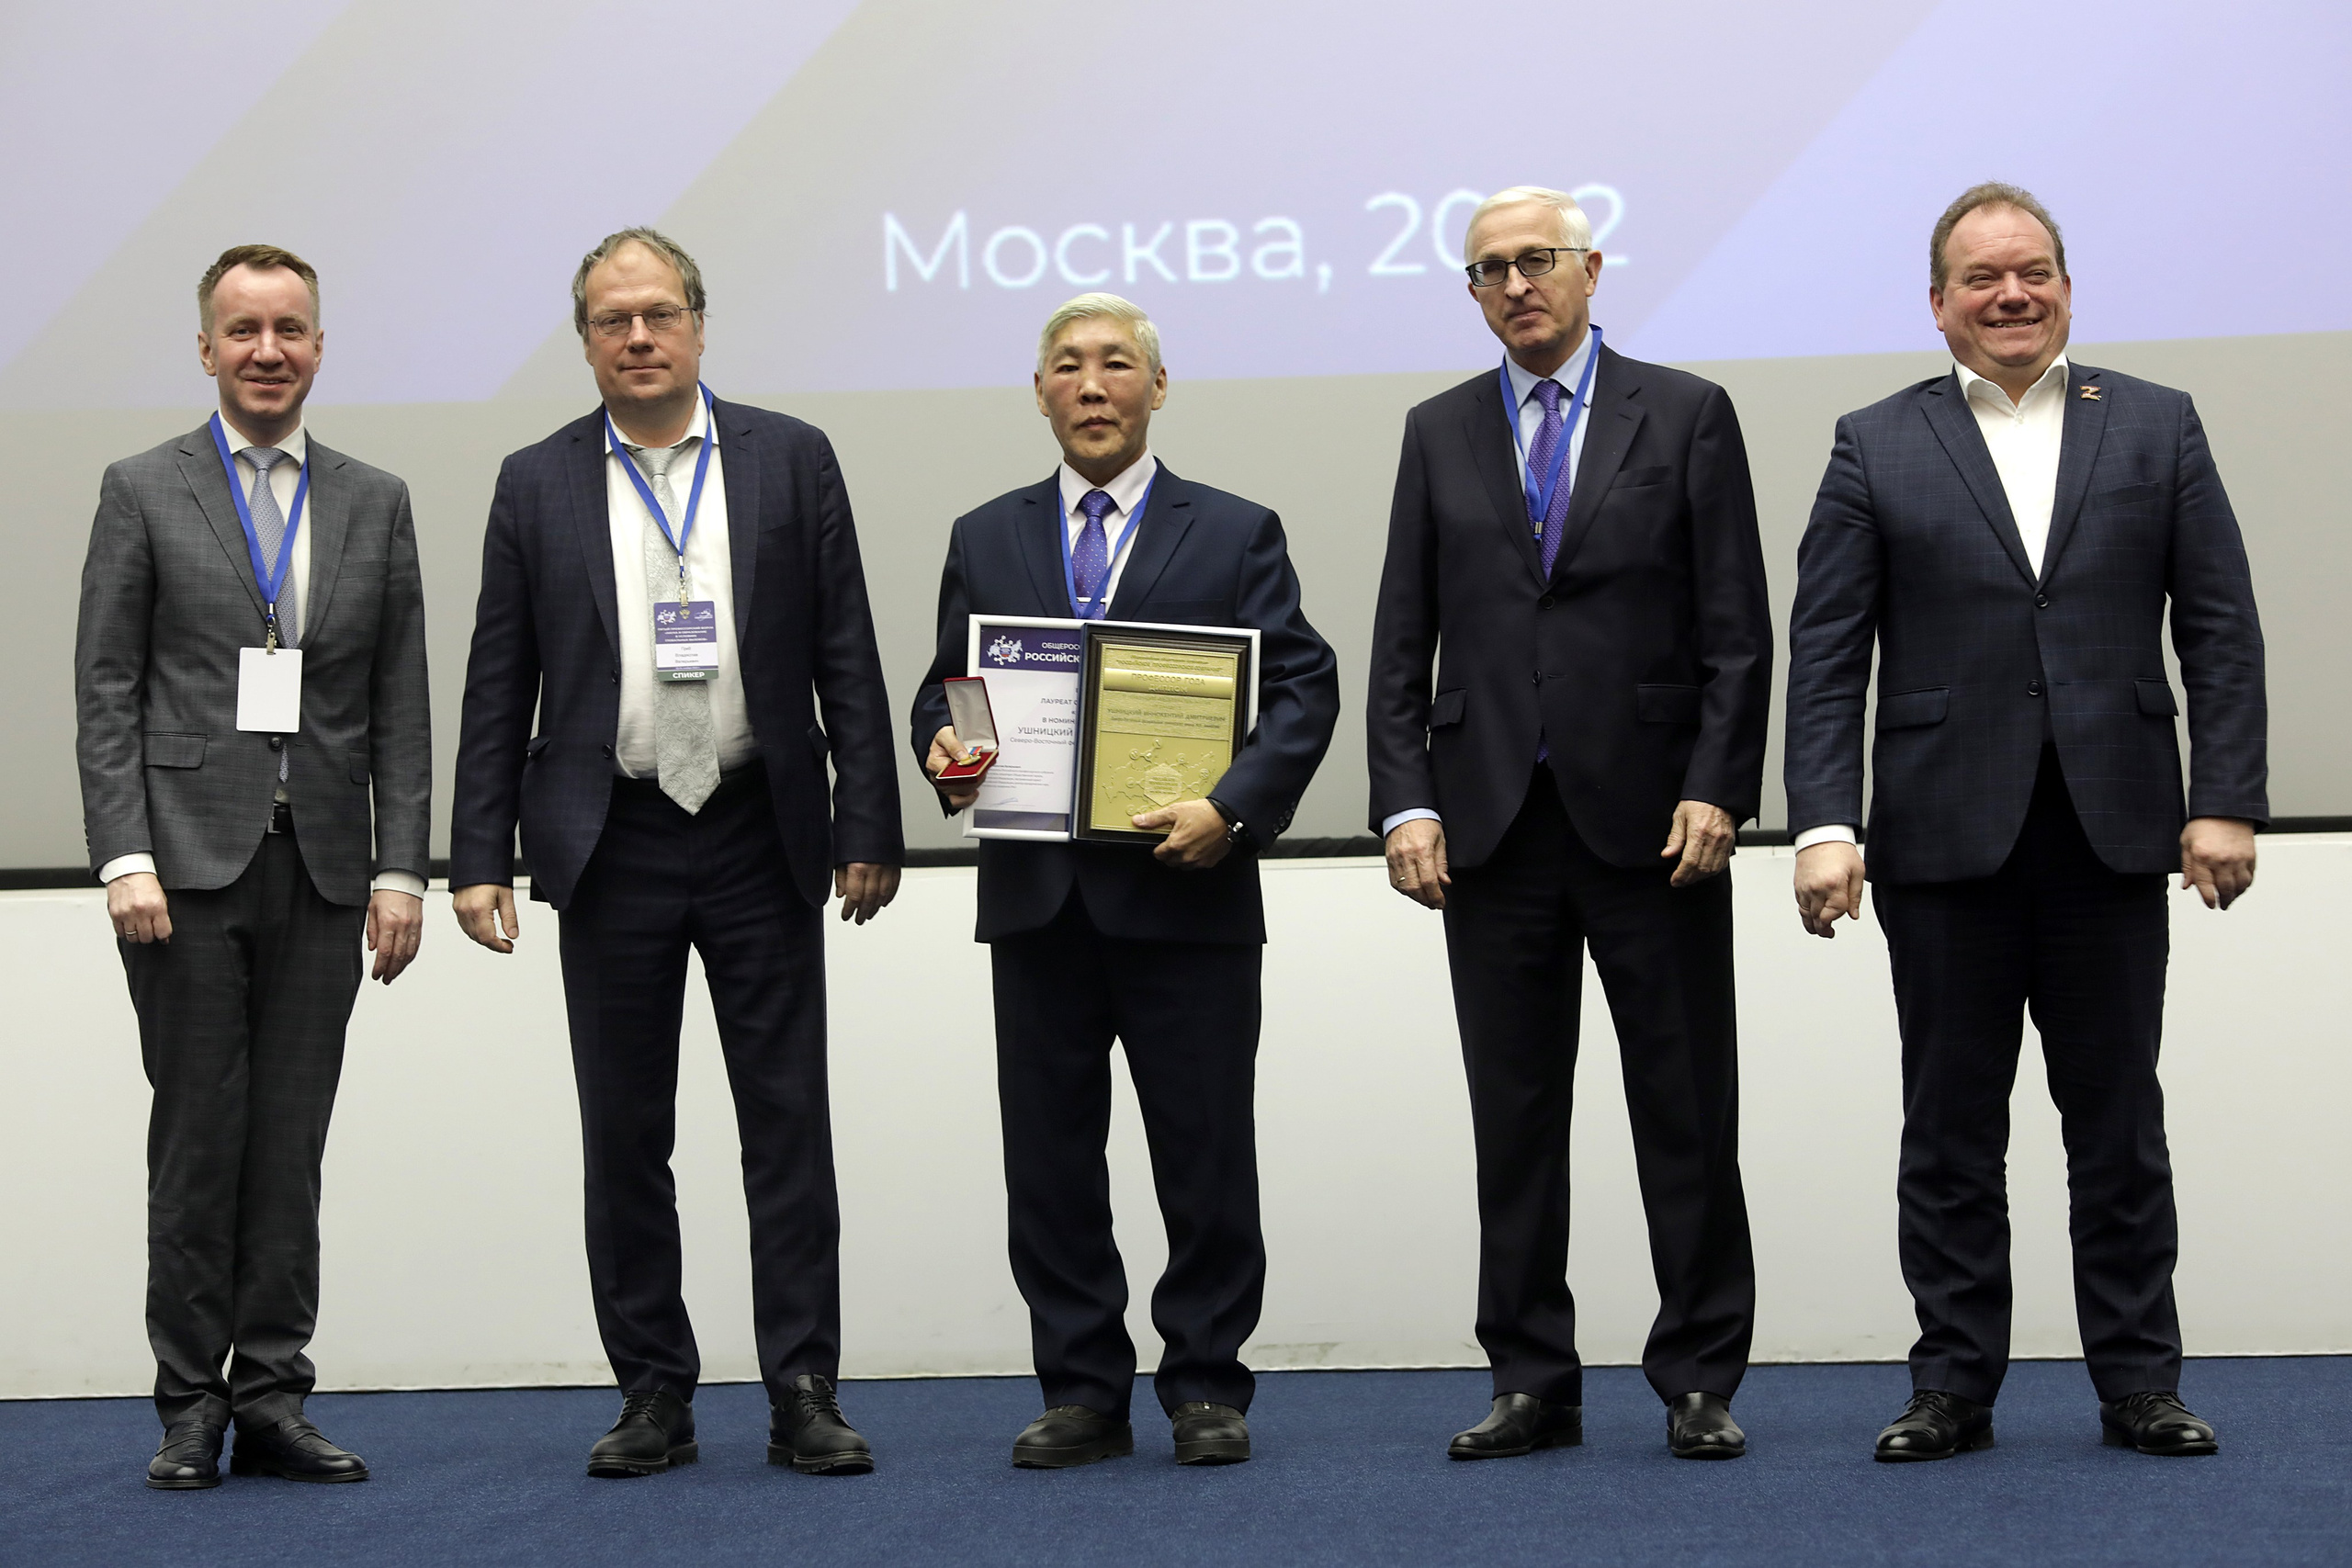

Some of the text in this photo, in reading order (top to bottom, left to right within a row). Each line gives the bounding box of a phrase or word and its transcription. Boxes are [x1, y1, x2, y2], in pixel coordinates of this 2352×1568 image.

[884, 183, 1630, 293] Москва, 202
[1131, 672, 1205, 685] ПРОФЕССОР ГОДА
[1148, 683, 1188, 694] ДИПЛОМ
[1017, 727, 1073, 737] УШНИЦКИЙ
